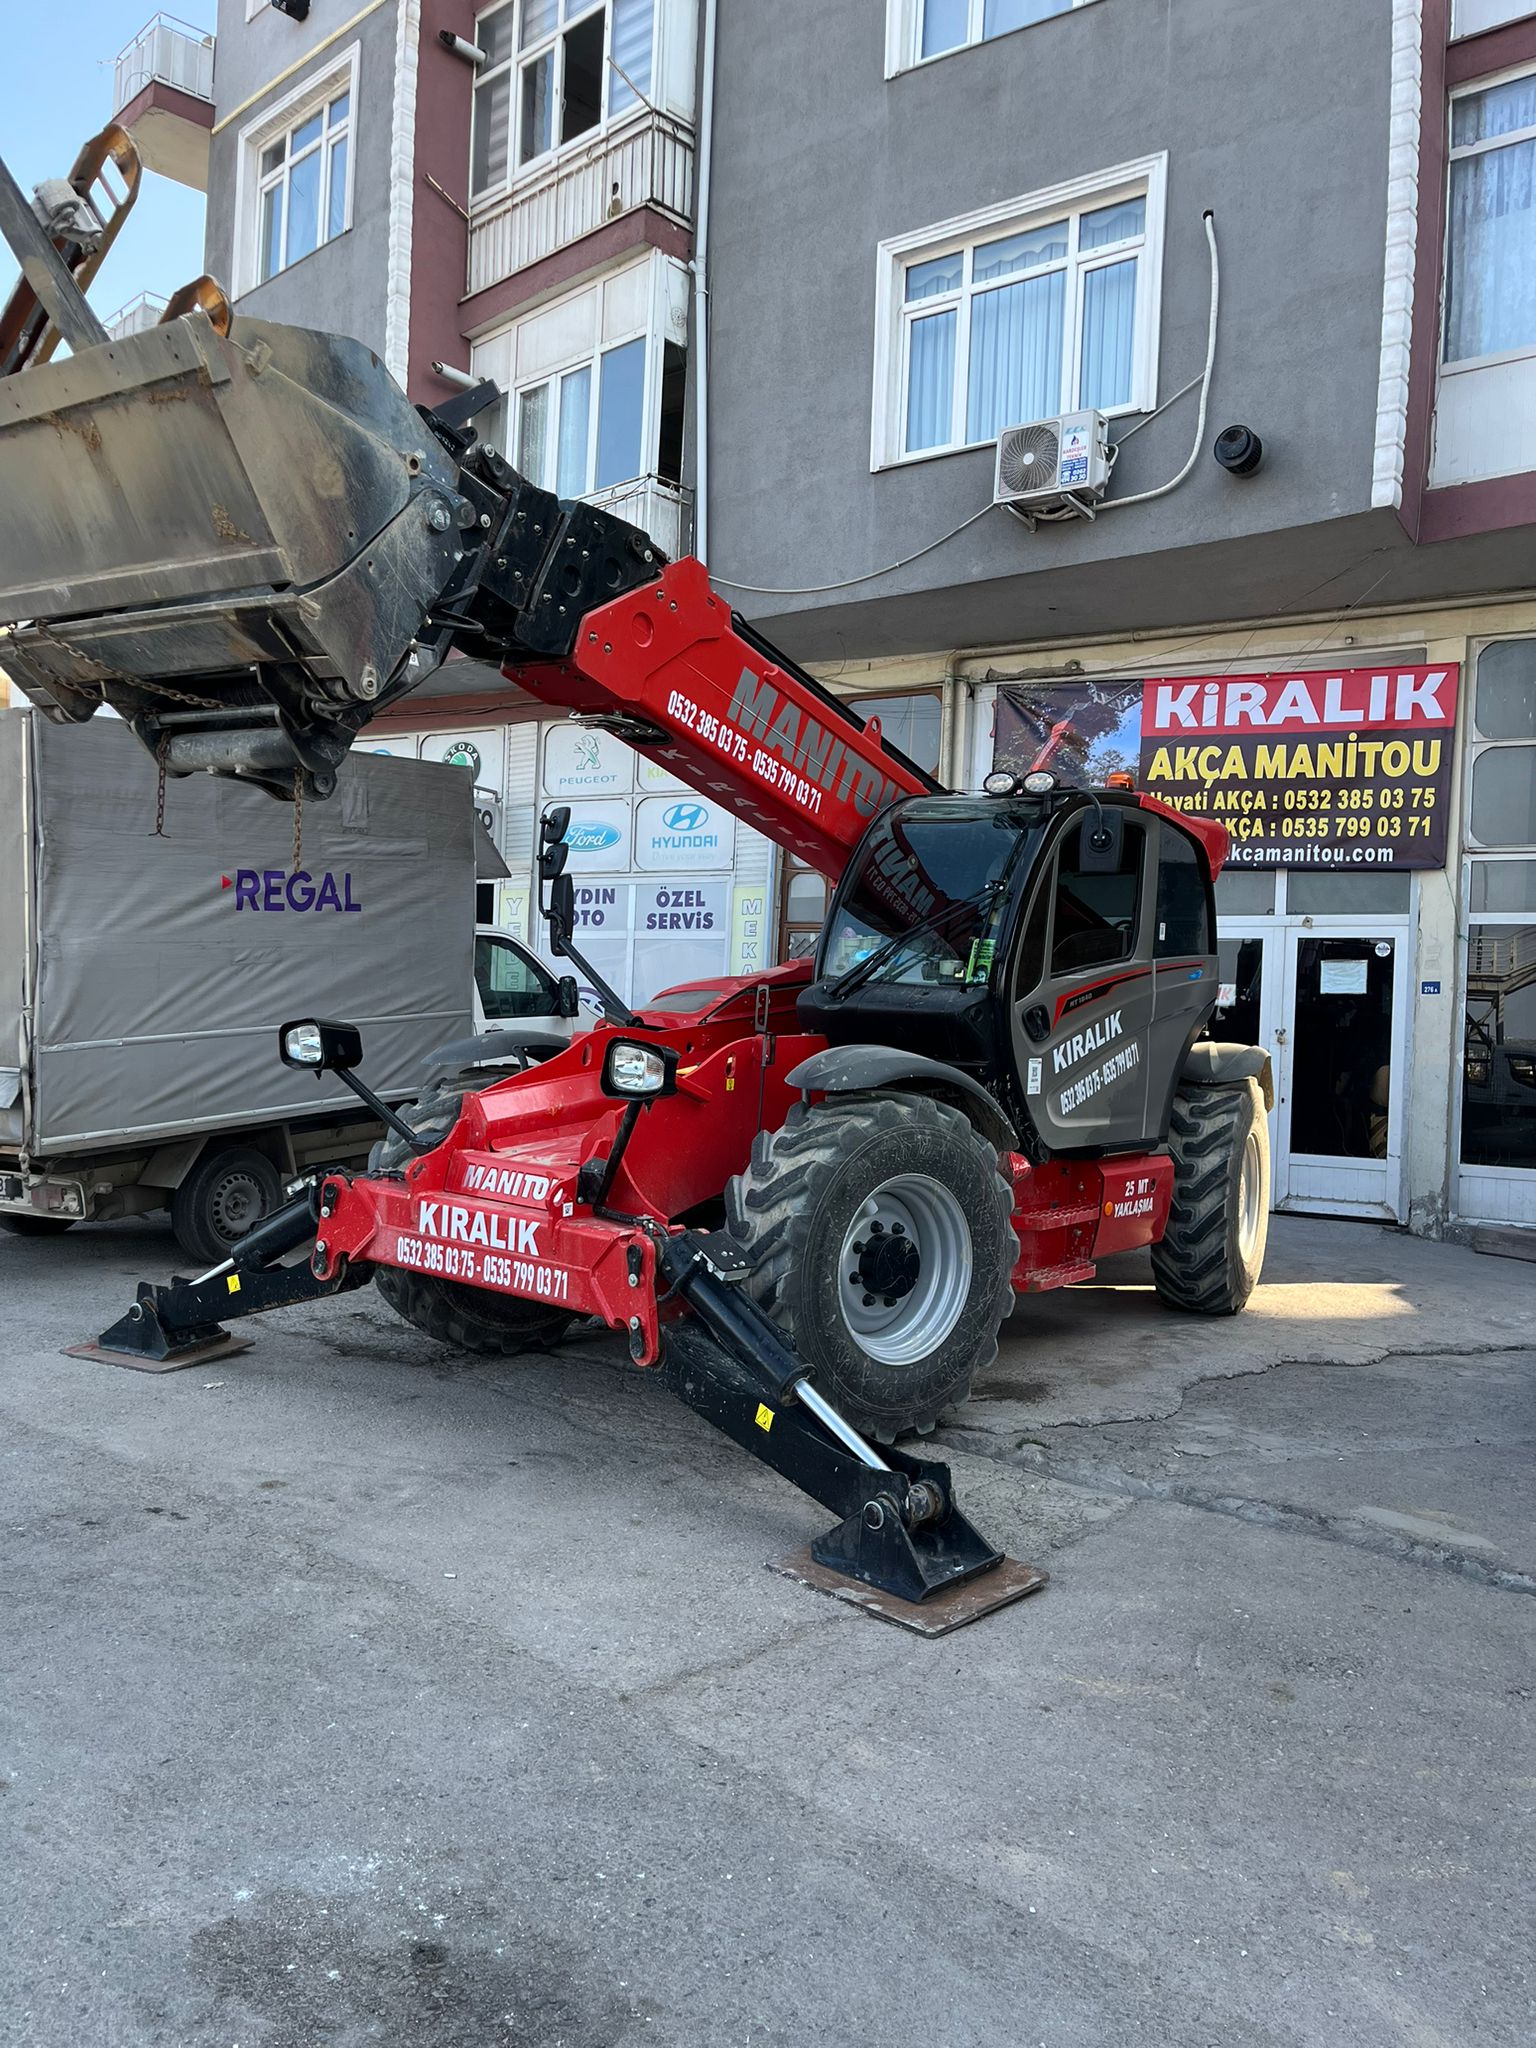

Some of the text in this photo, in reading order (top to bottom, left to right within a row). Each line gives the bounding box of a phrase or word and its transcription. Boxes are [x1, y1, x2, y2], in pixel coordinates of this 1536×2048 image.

[667, 690, 697, 731] 0532
[696, 711, 720, 743] 385
[718, 724, 733, 755] 03
[731, 732, 749, 762] 75
[753, 749, 779, 784] 0535
[777, 765, 797, 796] 799
[795, 779, 811, 805] 03
[808, 789, 823, 814] 71
[1147, 732, 1442, 789] AKÇA MANİTOU
[559, 775, 617, 785] PEUGEOT
[1213, 790, 1267, 815] AKÇA
[1284, 789, 1332, 810] 0532
[1337, 788, 1374, 809] 385
[1380, 788, 1404, 808] 03
[1411, 787, 1436, 808] 75
[566, 827, 606, 846] Ford
[652, 835, 718, 848] HYUNDAI
[1215, 817, 1264, 842] KÇA
[1282, 817, 1329, 838] 0535
[1335, 816, 1371, 837] 799
[1377, 816, 1402, 837] 03
[1408, 815, 1431, 837] 71
[1225, 843, 1394, 862] kcamanitou.com
[236, 869, 362, 912] REGAL
[573, 888, 615, 904] YDIN
[656, 887, 705, 908] ÖZEL
[1053, 1009, 1123, 1074] KIRALIK
[463, 1164, 565, 1200] MANITO
[1125, 1179, 1149, 1197] 25 MT
[1114, 1197, 1153, 1217] YAKLAŞMA
[418, 1200, 541, 1256] KIRALIK
[397, 1236, 422, 1267] 0532
[423, 1242, 444, 1271] 385
[445, 1247, 459, 1275] 03
[460, 1249, 475, 1278] 75
[483, 1254, 512, 1287] 0535
[513, 1261, 535, 1292] 799
[536, 1266, 552, 1295] 03
[553, 1269, 569, 1299] 71
